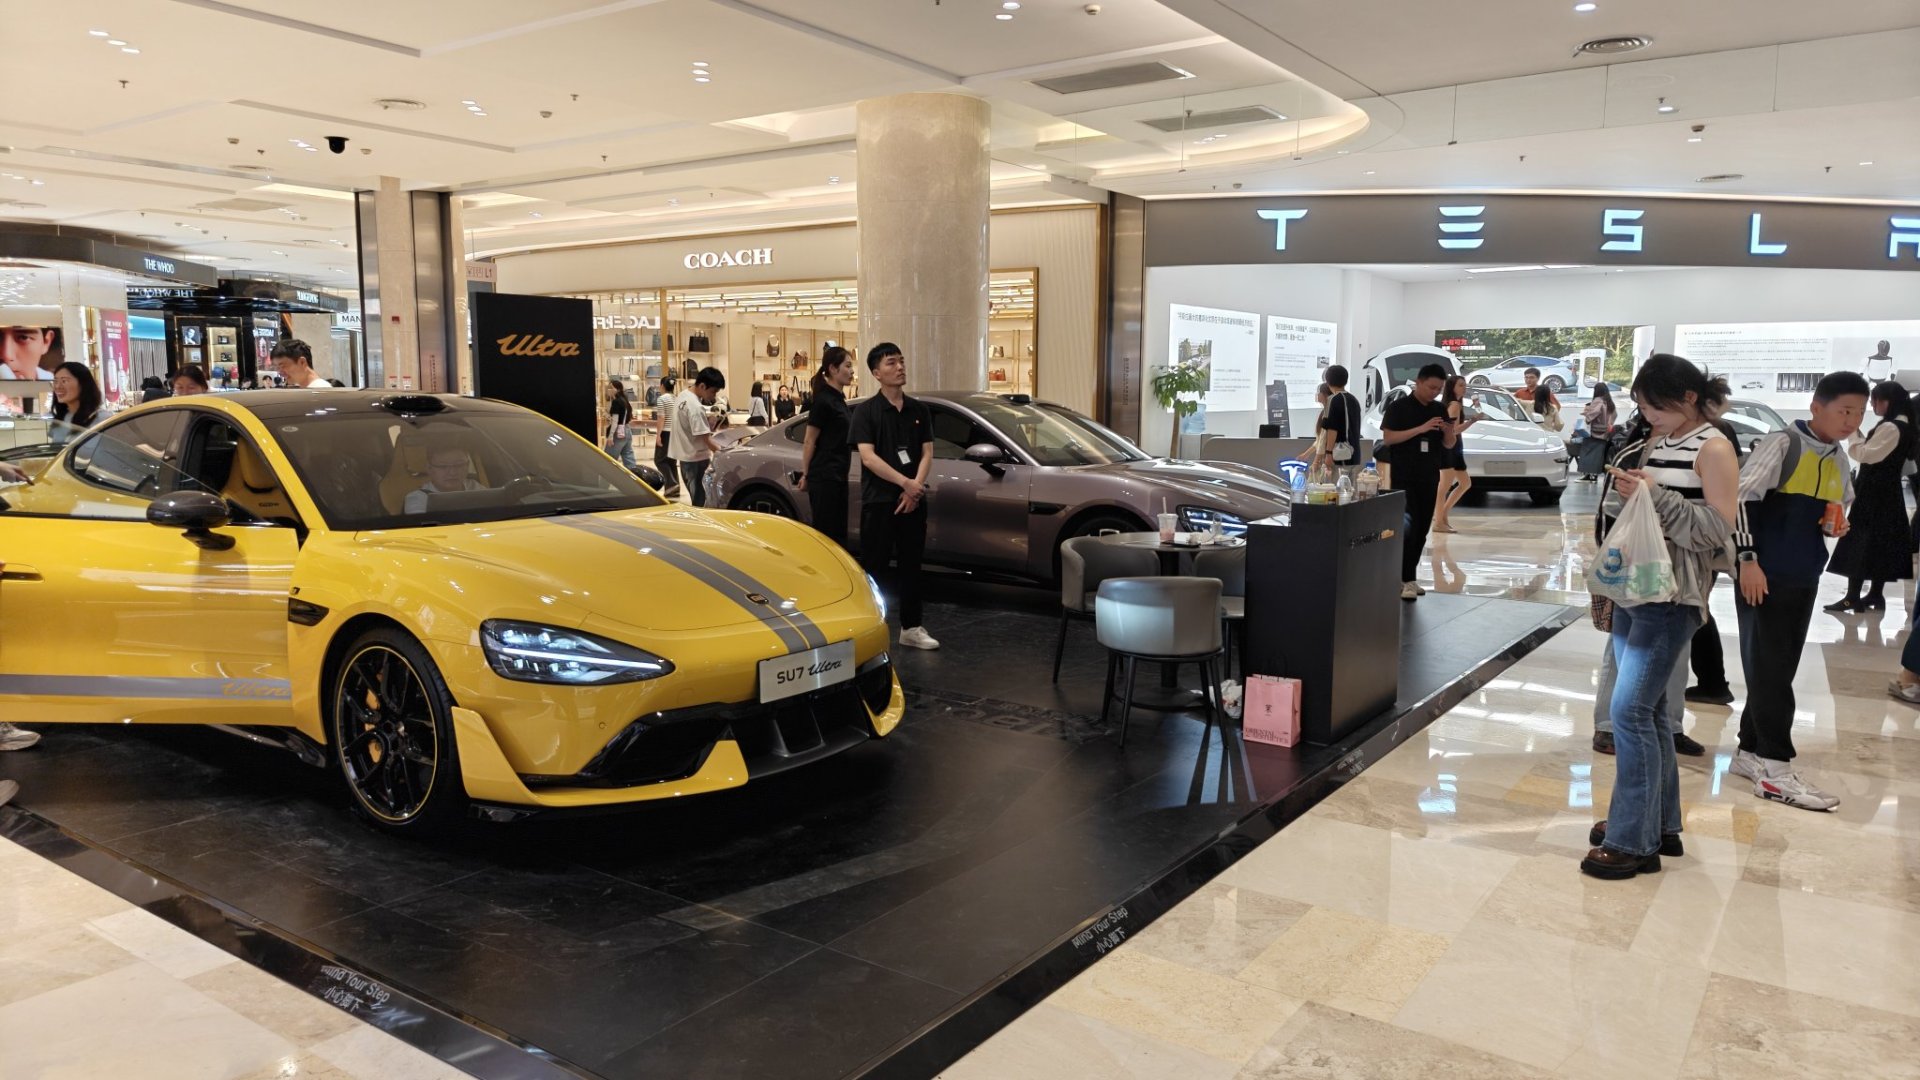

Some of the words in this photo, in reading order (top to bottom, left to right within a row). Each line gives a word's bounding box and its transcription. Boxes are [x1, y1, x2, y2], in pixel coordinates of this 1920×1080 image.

[1256, 205, 1920, 258] TESLA
[144, 258, 157, 271] THE
[156, 261, 175, 274] WHOO
[683, 248, 773, 269] COACH
[496, 334, 580, 357] Ultra
[776, 666, 805, 685] SU7
[808, 659, 842, 677] Ultra
[1092, 918, 1110, 935] Your
[1107, 905, 1129, 924] Step
[345, 972, 368, 992] Your
[366, 982, 391, 1003] Step
